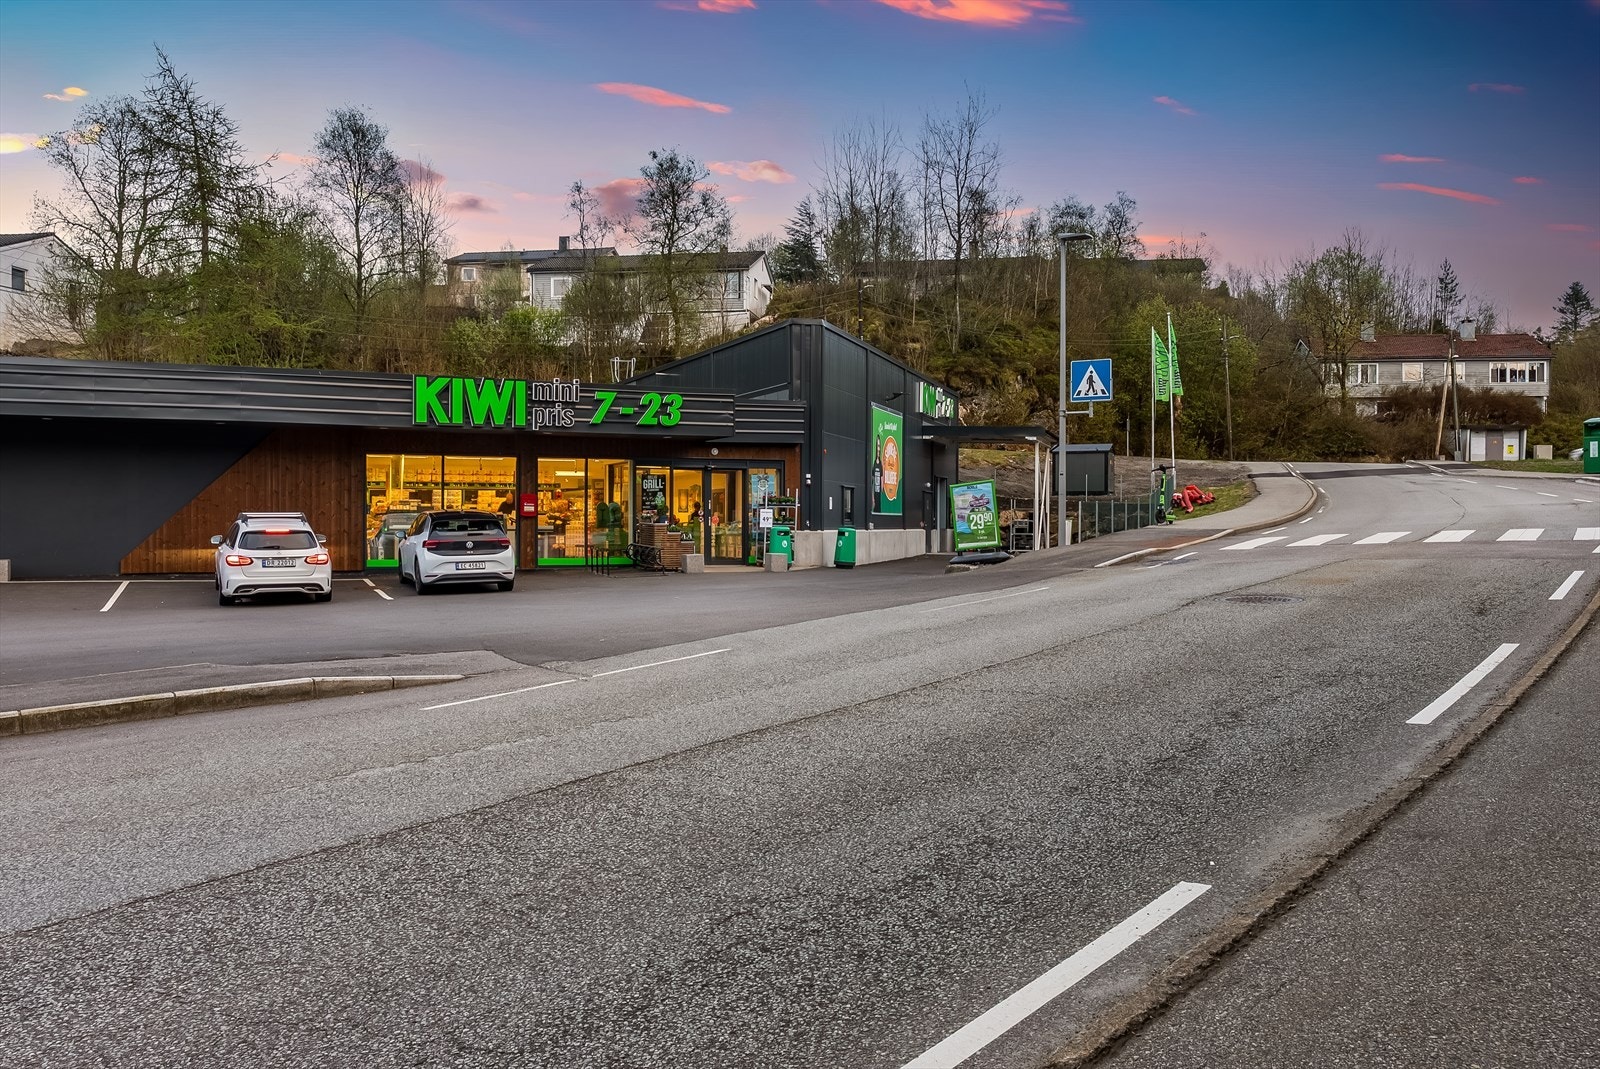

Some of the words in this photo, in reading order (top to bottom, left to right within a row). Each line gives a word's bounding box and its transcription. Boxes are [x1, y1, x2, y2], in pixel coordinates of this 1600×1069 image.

[413, 375, 528, 427] KIWI
[532, 378, 580, 402] mini
[532, 403, 575, 430] pris
